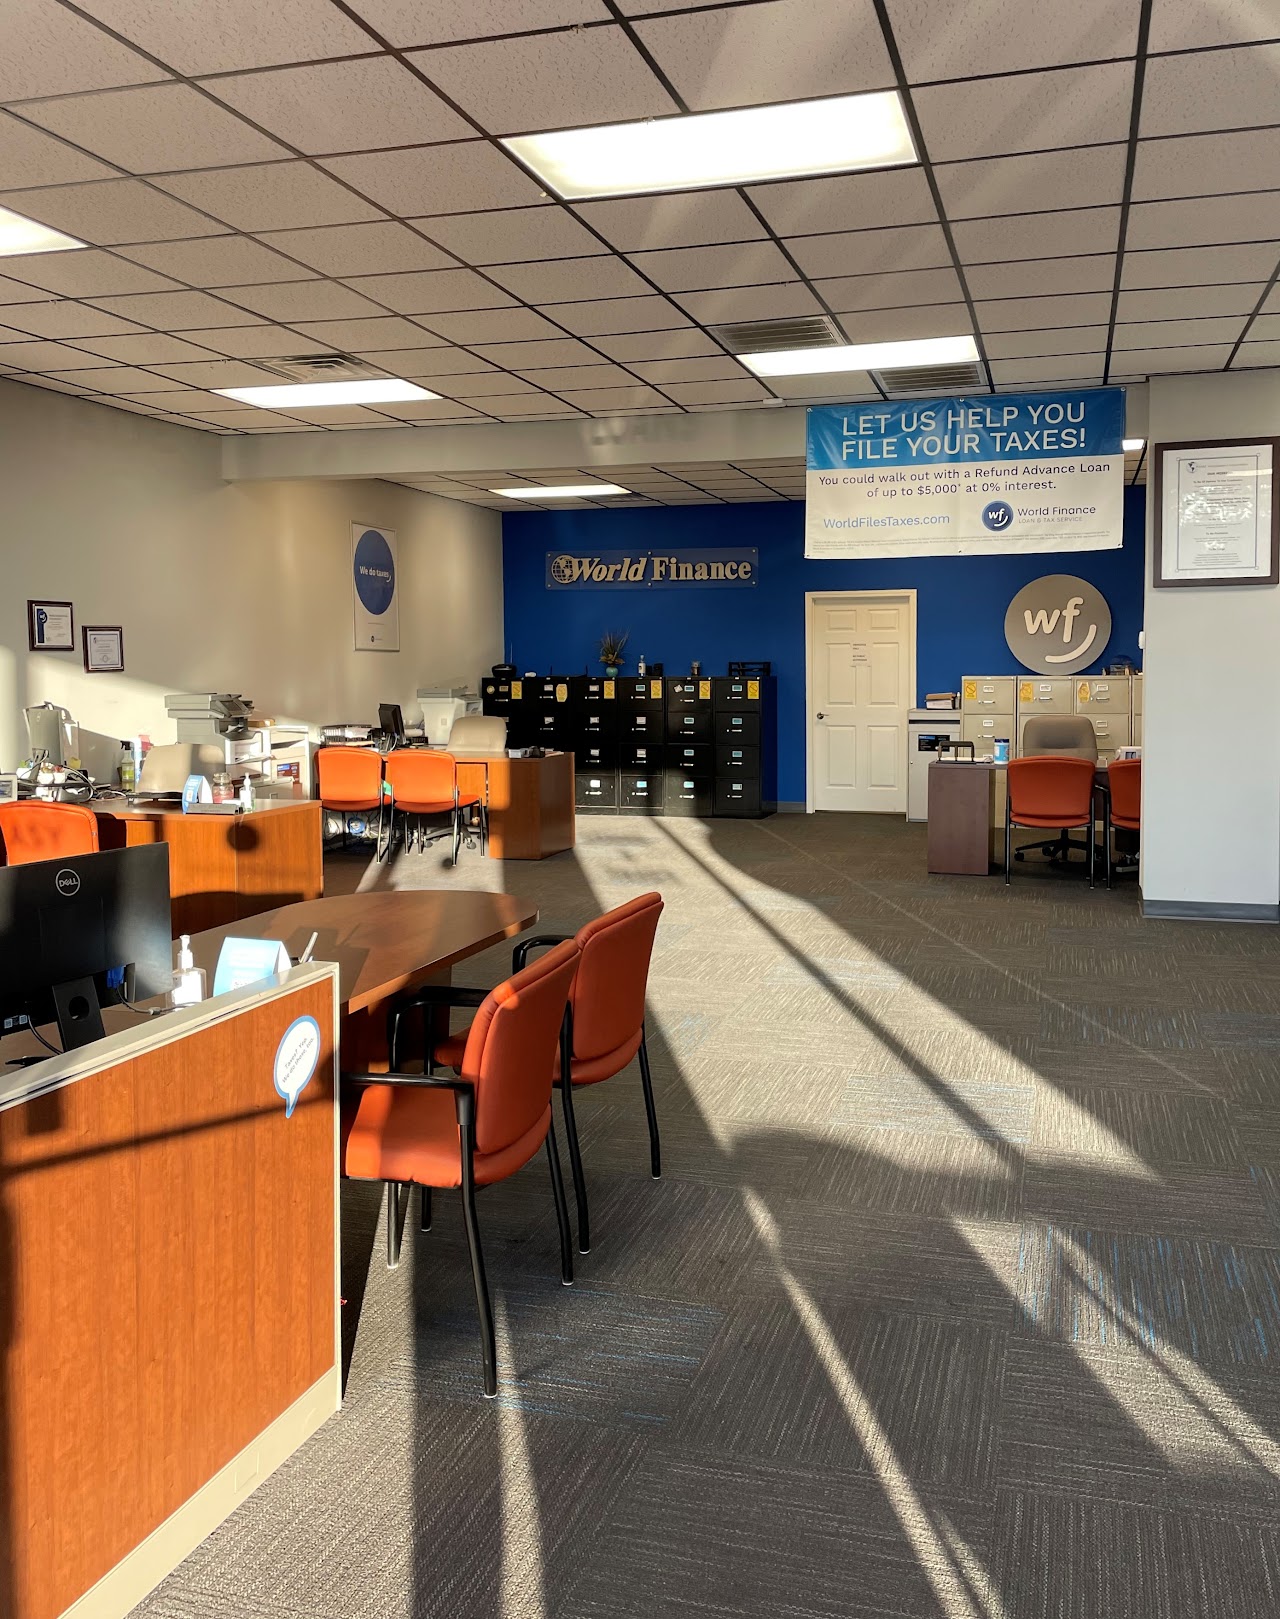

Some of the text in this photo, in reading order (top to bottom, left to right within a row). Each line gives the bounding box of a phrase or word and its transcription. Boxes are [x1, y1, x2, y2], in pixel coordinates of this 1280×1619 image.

[842, 402, 1086, 436] LET US HELP YOU
[842, 428, 1087, 461] FILE YOUR TAXES!
[819, 476, 838, 486] You
[842, 474, 875, 485] could
[878, 472, 907, 483] walk
[910, 471, 930, 481] out
[933, 469, 960, 480] with
[975, 466, 1018, 478] Refund
[1022, 464, 1075, 476] Advance
[1080, 463, 1110, 473] Loan
[867, 487, 879, 497] of
[882, 488, 897, 499] up
[901, 487, 913, 496] to
[966, 484, 977, 493] at
[982, 482, 1000, 492] 0%
[1005, 480, 1057, 491] interest.
[988, 507, 1005, 522] wf
[1017, 505, 1096, 517] World Finance
[823, 514, 950, 529] WorldFilesTaxes.com
[359, 565, 369, 575] We
[369, 567, 376, 576] do
[571, 556, 752, 582] World Finance
[1024, 596, 1084, 643] wf
[59, 878, 78, 887] DELL
